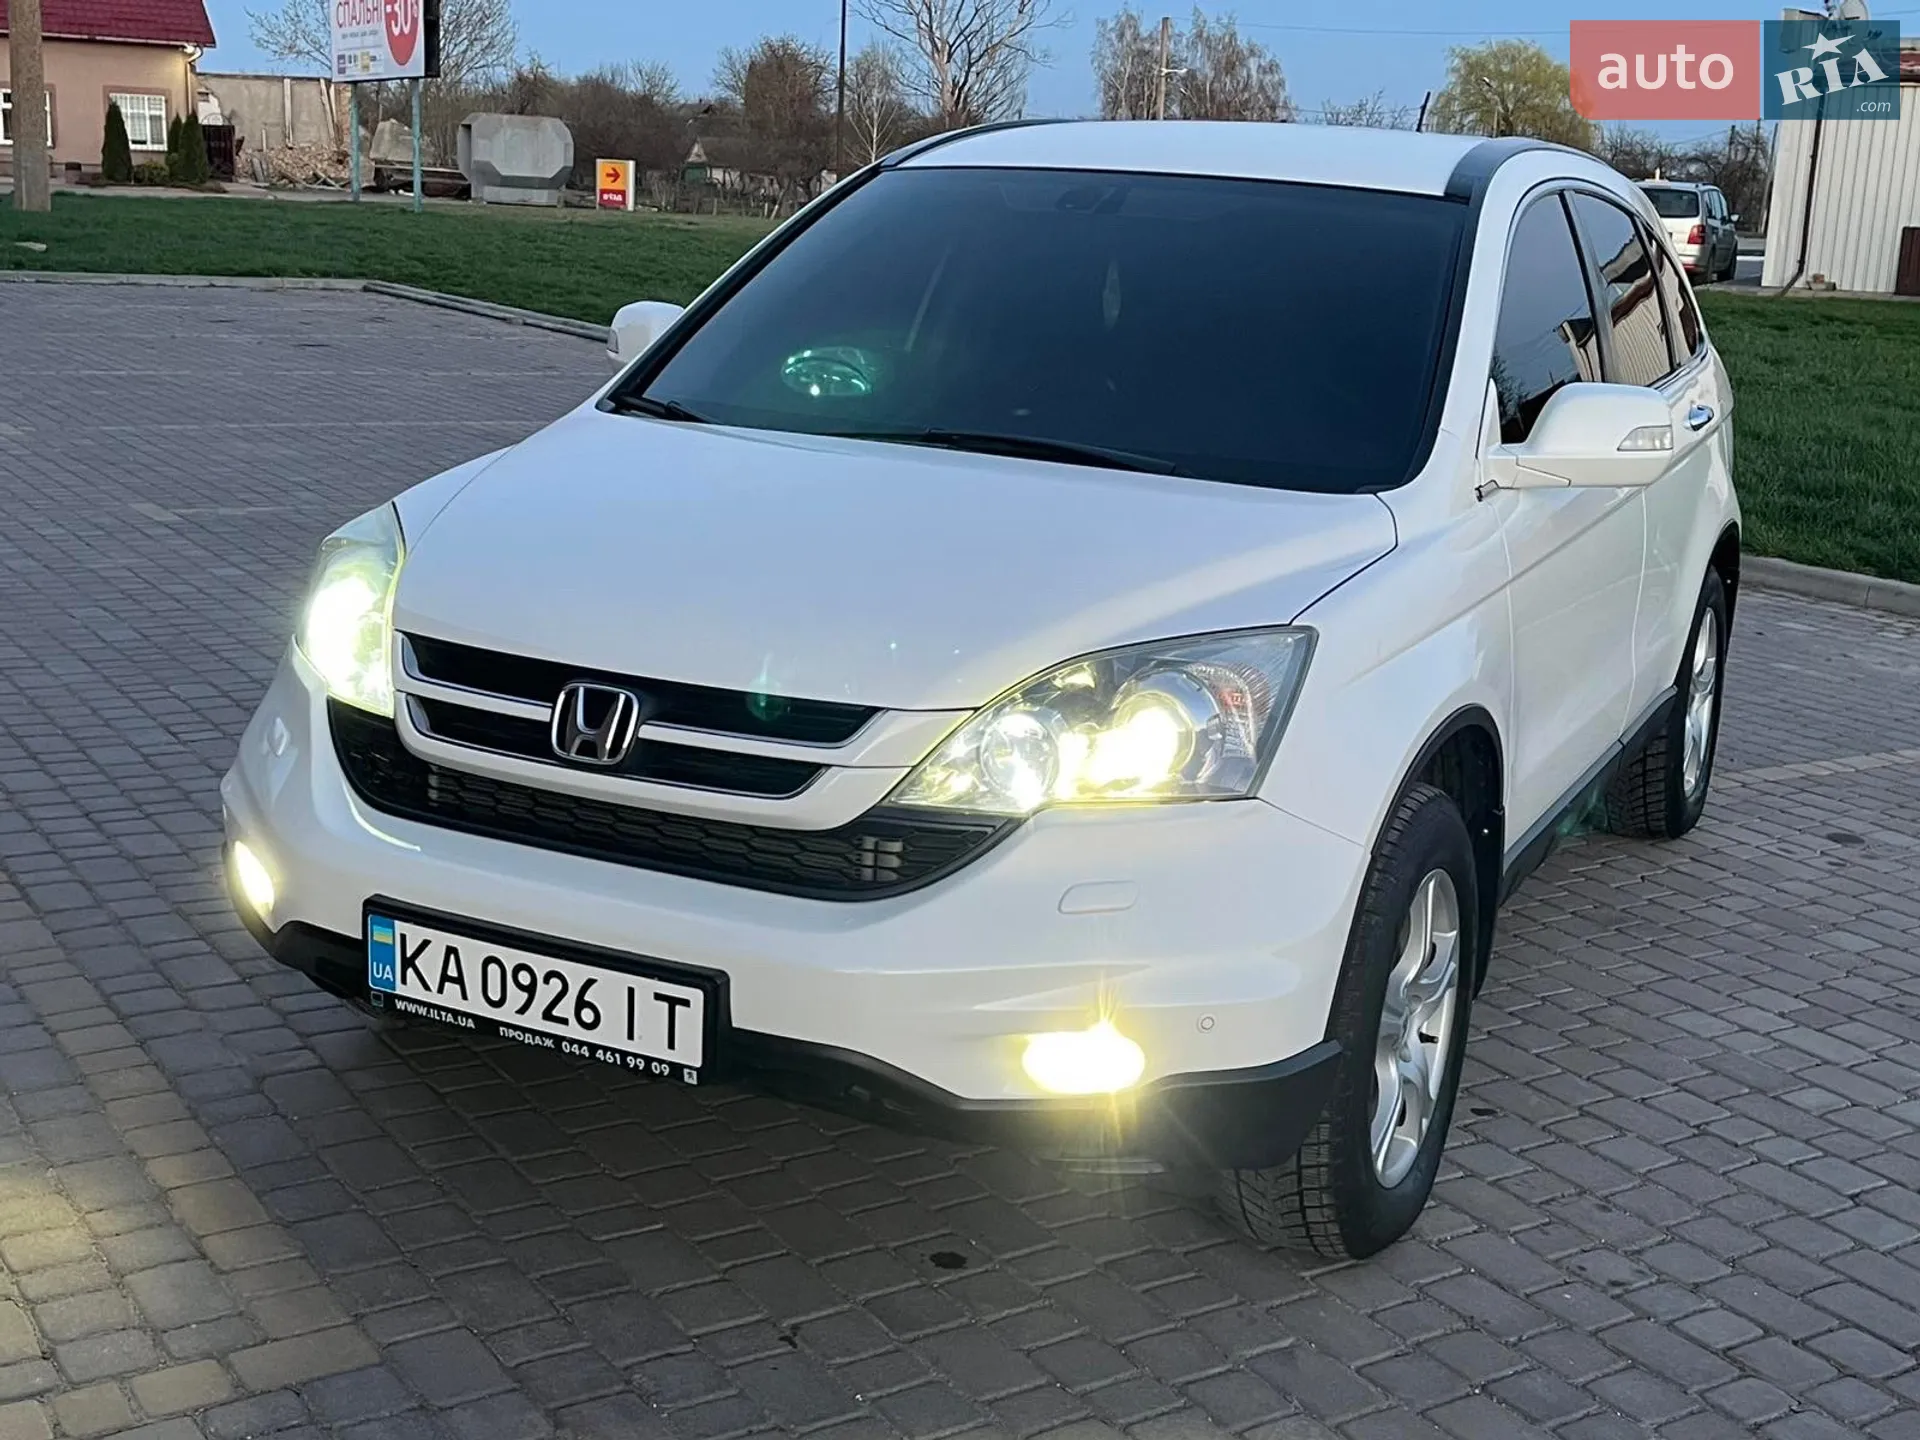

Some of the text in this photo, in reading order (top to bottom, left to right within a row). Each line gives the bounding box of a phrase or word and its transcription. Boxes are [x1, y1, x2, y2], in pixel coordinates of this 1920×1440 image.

[373, 961, 394, 982] UA
[400, 932, 691, 1051] KA 0926 IT
[394, 998, 476, 1029] WWW.ILTA.UA
[499, 1026, 670, 1076] ПРОДАЖ 044 461 99 09
